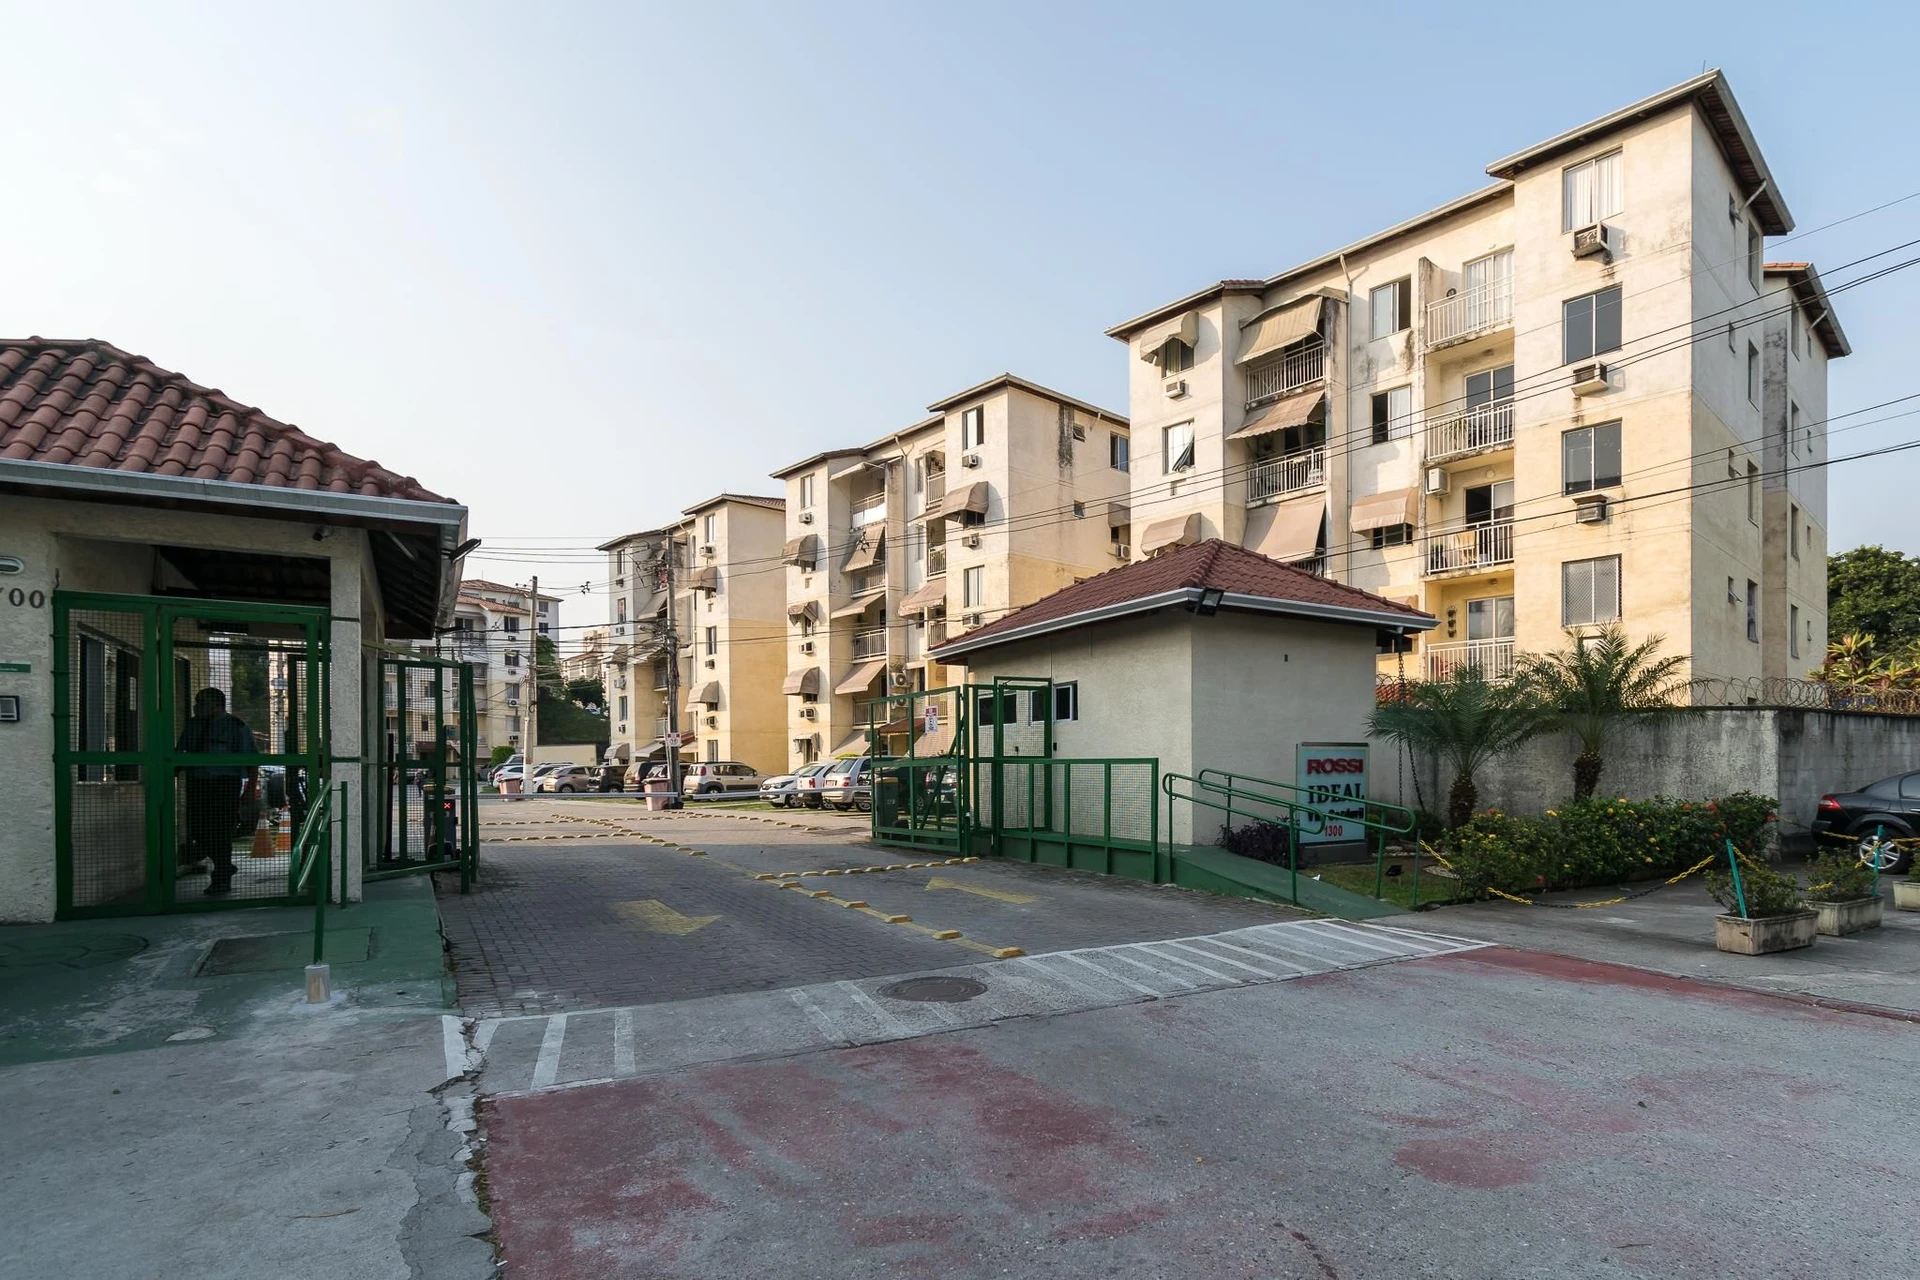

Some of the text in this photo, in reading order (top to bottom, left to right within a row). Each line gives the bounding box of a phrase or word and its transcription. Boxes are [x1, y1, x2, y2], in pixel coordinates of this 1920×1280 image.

[0, 587, 45, 609] 00
[1307, 758, 1364, 775] ROSSI
[1307, 782, 1365, 804] IDEAL
[1324, 825, 1344, 838] 1300
